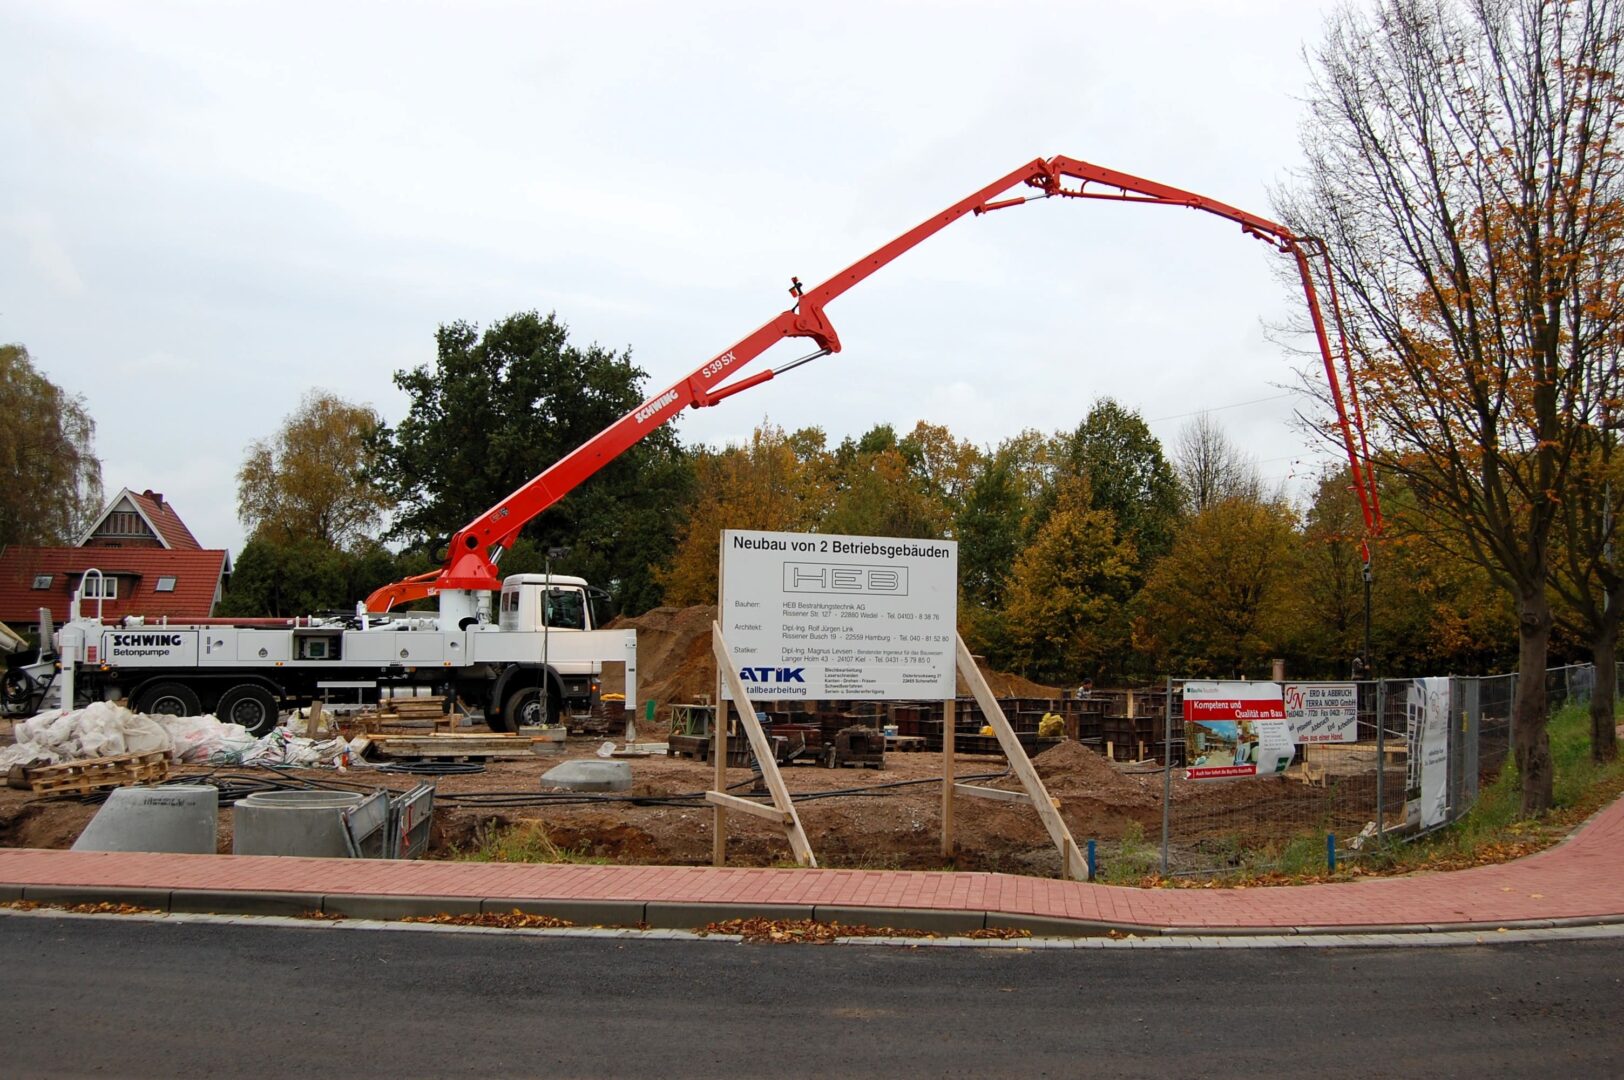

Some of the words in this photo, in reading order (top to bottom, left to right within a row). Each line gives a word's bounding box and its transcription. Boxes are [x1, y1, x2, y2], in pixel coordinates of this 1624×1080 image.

[710, 360, 723, 373] 39
[721, 351, 736, 366] SX
[635, 389, 679, 424] SCHWING
[733, 535, 787, 551] Neubau
[791, 541, 816, 552] von
[820, 540, 828, 553] 2
[832, 540, 949, 559] Betriebsgebäuden
[793, 567, 899, 590] HEB
[734, 600, 761, 608] Bauherr:
[797, 602, 854, 611] Bestrahlungstechnik
[734, 623, 763, 631] Architekt:
[820, 625, 841, 633] Jürgen
[113, 634, 182, 647] SCHWING
[865, 634, 891, 642] Hamburg
[113, 648, 170, 657] Betonpumpe
[807, 647, 831, 656] Magnus
[781, 655, 804, 664] Langer
[746, 685, 807, 696] tallbearbeitung
[1309, 689, 1320, 697] ERD
[1321, 689, 1326, 697] &
[1327, 689, 1352, 697] ABBRUCH
[1193, 700, 1229, 711] Kompetenz
[1230, 700, 1242, 709] und
[1305, 699, 1323, 707] TERRA
[1340, 698, 1356, 706] GmbH
[1234, 709, 1259, 719] Qualität
[1270, 709, 1283, 717] Bau
[1311, 716, 1330, 732] Abbruch
[1327, 722, 1336, 732] Erd
[1337, 715, 1356, 732] Arbeiten
